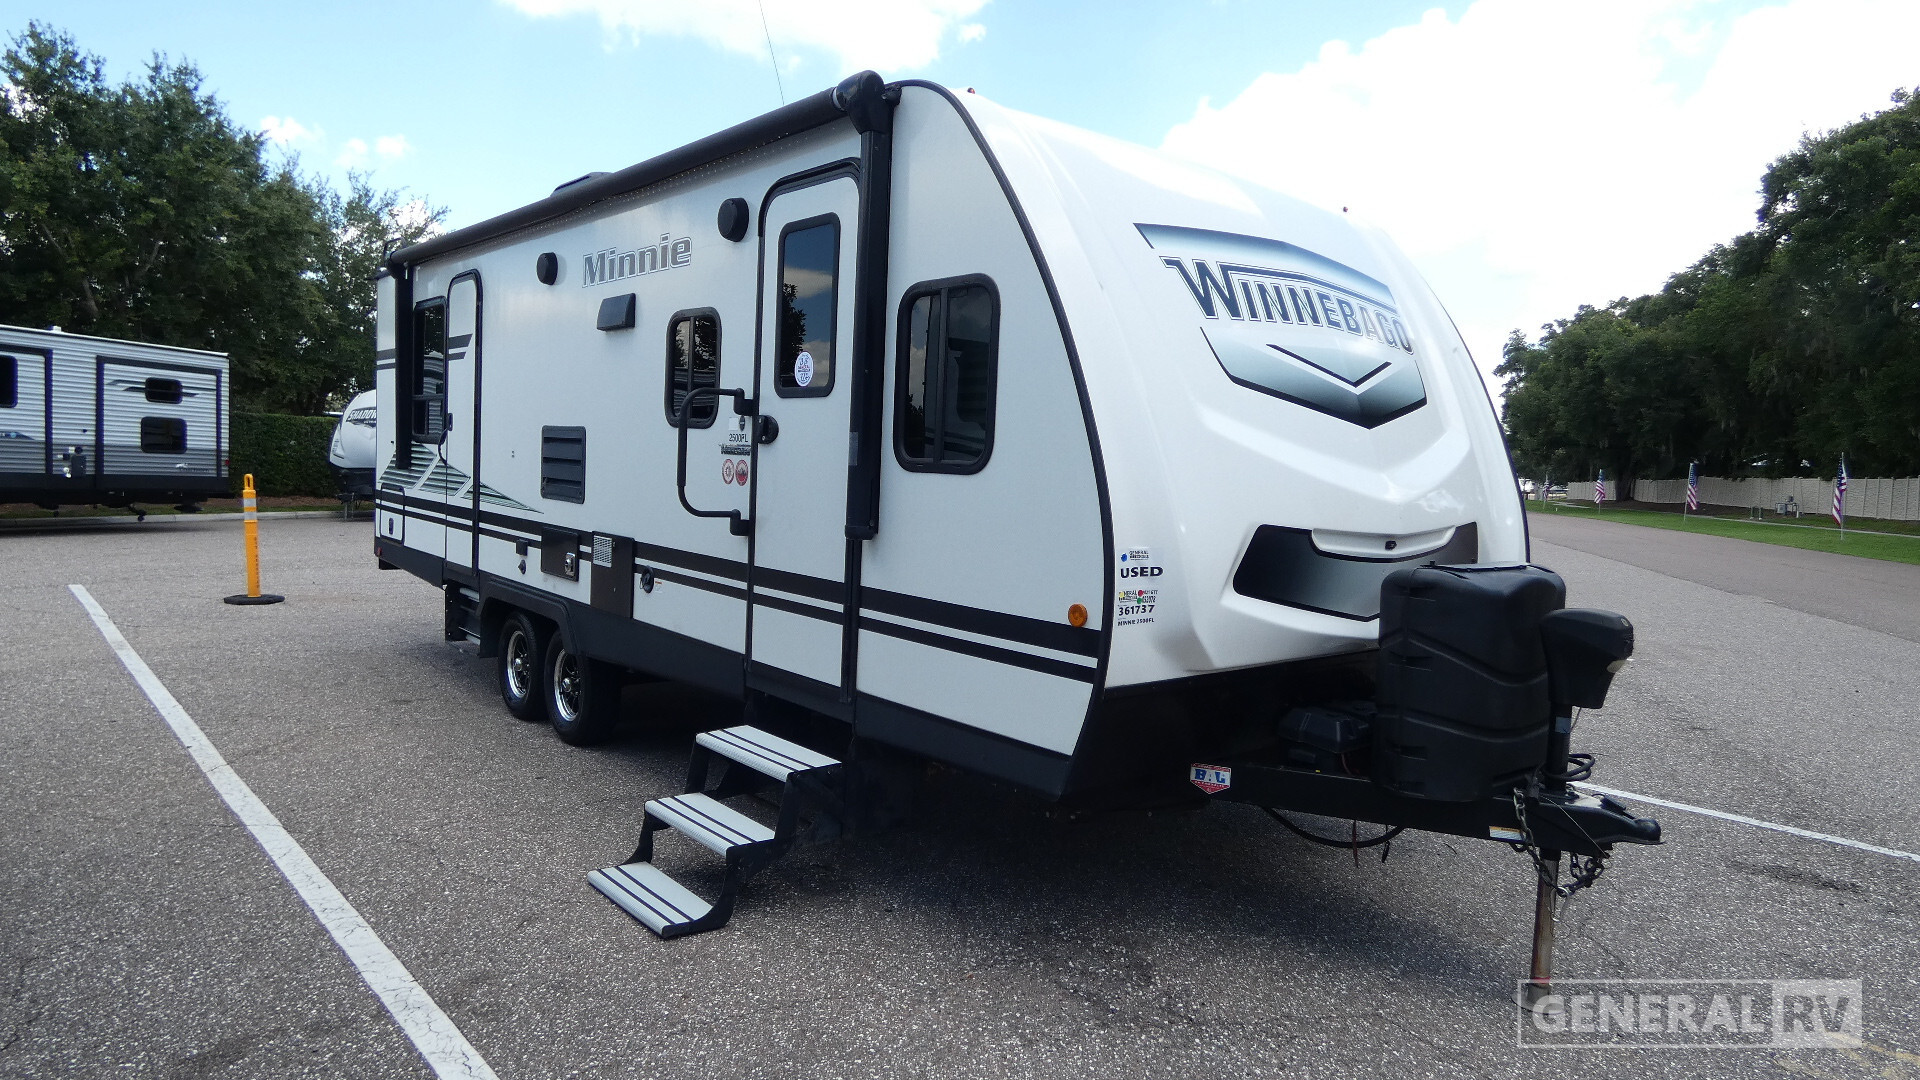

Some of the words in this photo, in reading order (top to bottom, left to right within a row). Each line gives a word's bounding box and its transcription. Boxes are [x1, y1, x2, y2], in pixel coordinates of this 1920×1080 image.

[582, 233, 692, 288] Minnie
[1159, 256, 1414, 355] WINNEBAGO
[1120, 567, 1163, 578] USED
[1119, 604, 1155, 616] 361737
